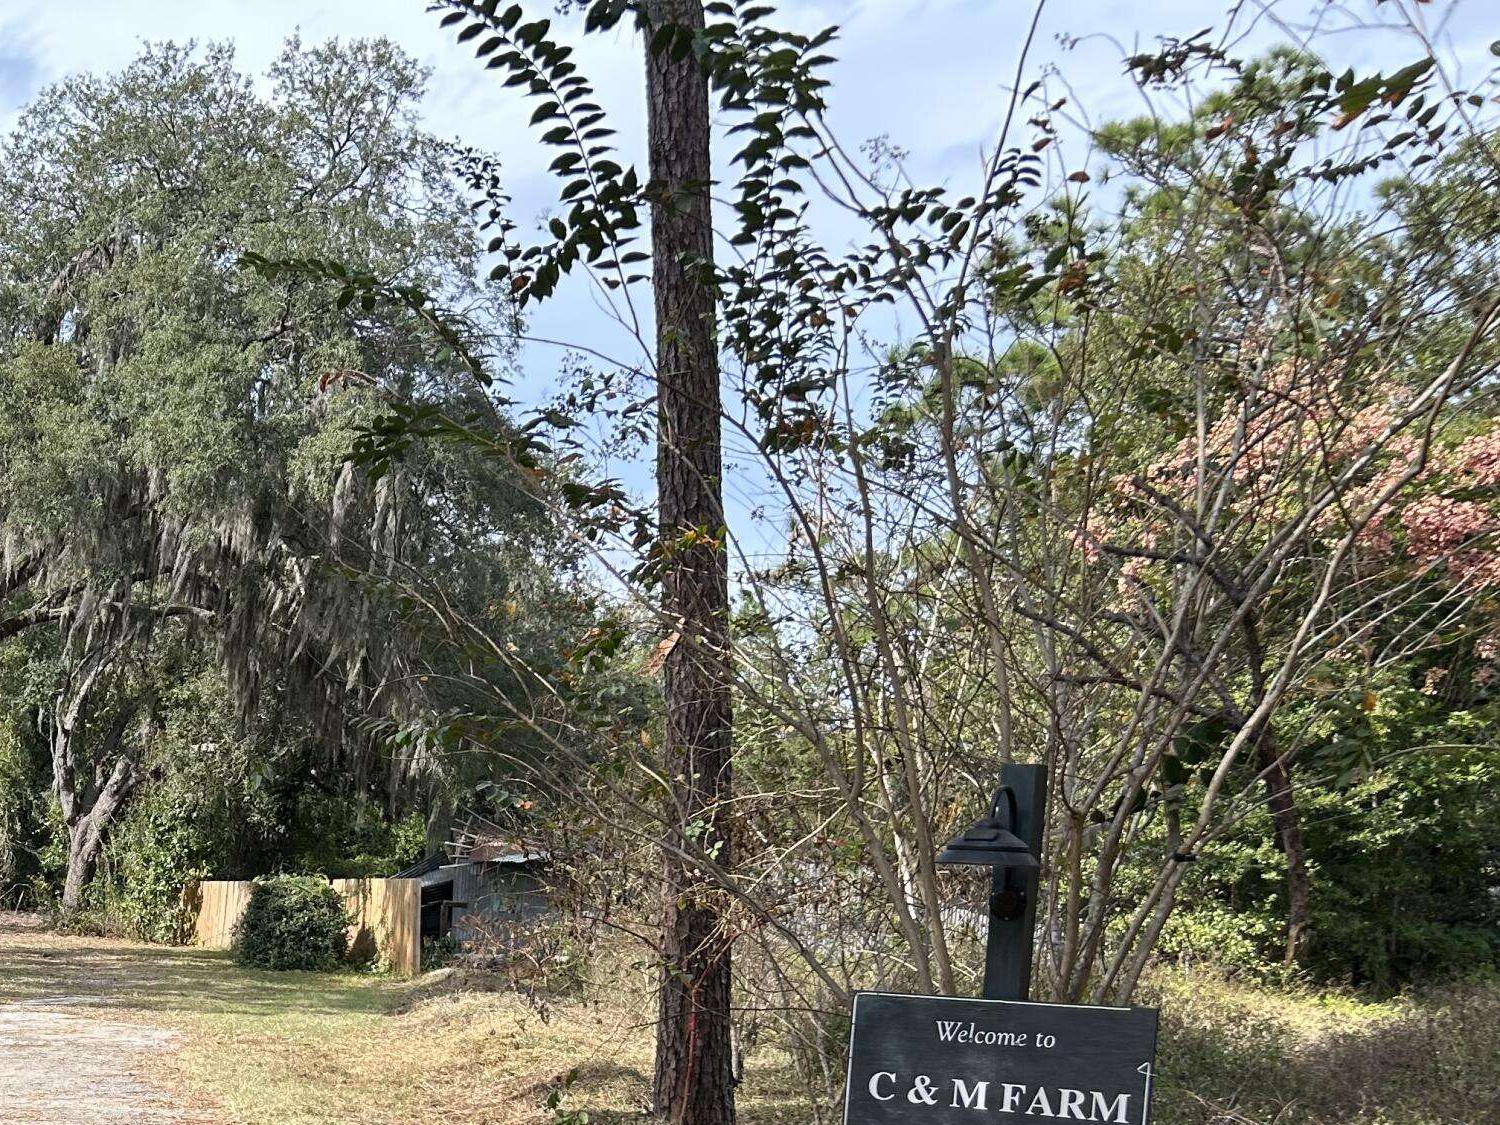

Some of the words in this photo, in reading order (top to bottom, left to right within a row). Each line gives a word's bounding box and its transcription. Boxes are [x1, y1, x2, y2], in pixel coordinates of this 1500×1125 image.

[936, 1020, 1027, 1047] Welcome
[1036, 1034, 1056, 1048] to
[868, 1072, 896, 1101] C
[907, 1075, 939, 1105] &
[949, 1078, 990, 1110] M
[999, 1083, 1131, 1124] FARM
